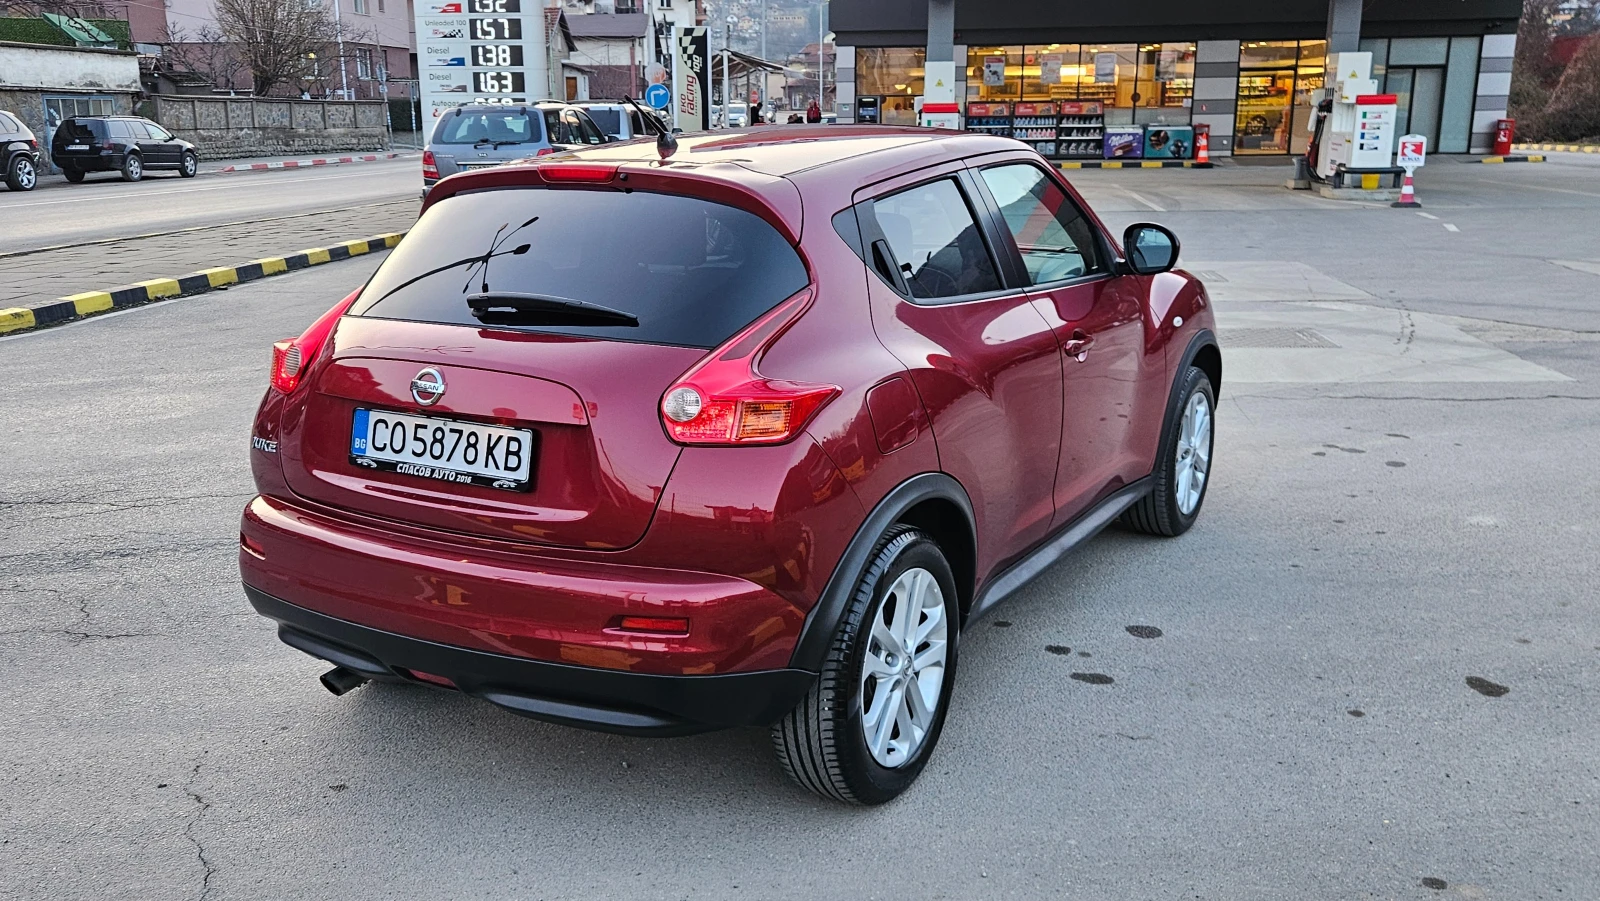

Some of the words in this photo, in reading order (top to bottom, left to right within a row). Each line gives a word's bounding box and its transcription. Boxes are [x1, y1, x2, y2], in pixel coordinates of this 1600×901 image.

[687, 75, 696, 115] racing
[412, 381, 440, 391] NISSAN
[252, 436, 278, 453] JUKE
[354, 438, 367, 449] BG
[396, 463, 432, 477] СПАСОВ
[432, 468, 456, 481] АУТО
[456, 474, 472, 484] 2016
